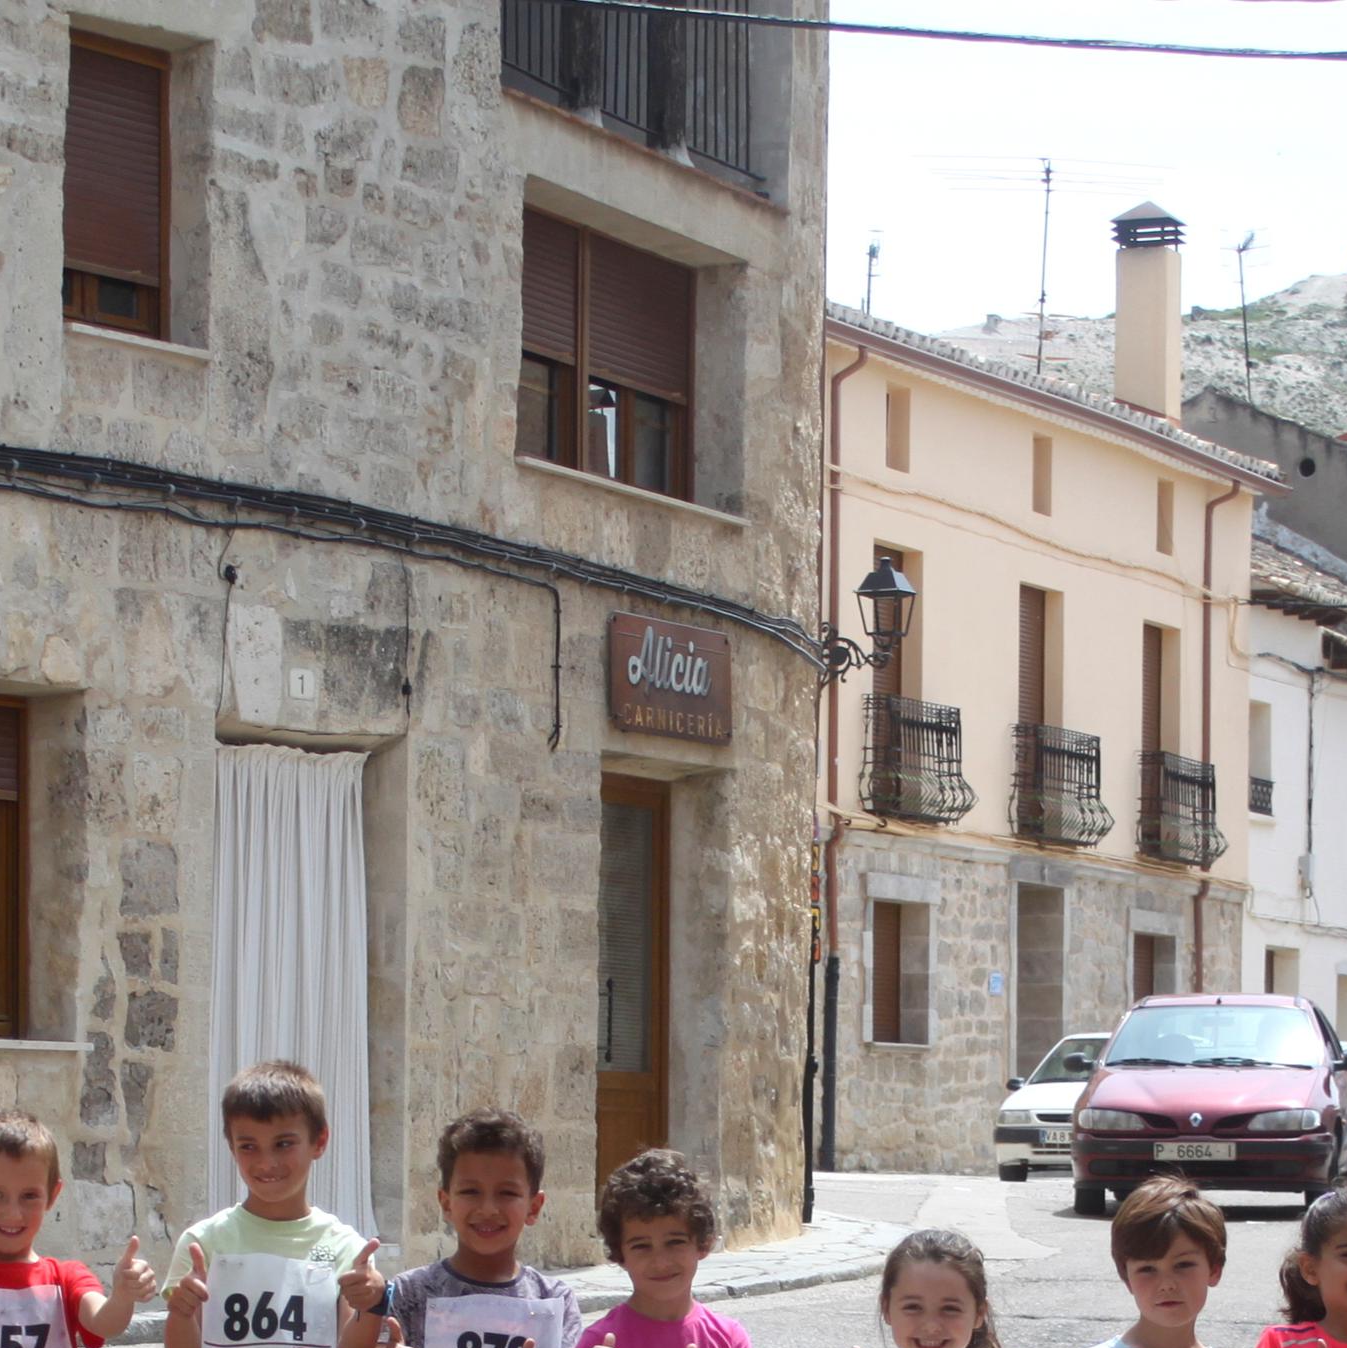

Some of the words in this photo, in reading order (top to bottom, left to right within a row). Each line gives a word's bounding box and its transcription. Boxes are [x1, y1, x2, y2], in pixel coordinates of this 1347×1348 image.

[628, 625, 712, 697] Alicia
[297, 674, 305, 695] 1
[624, 703, 724, 740] CARNICERÍA
[223, 1291, 307, 1342] 864
